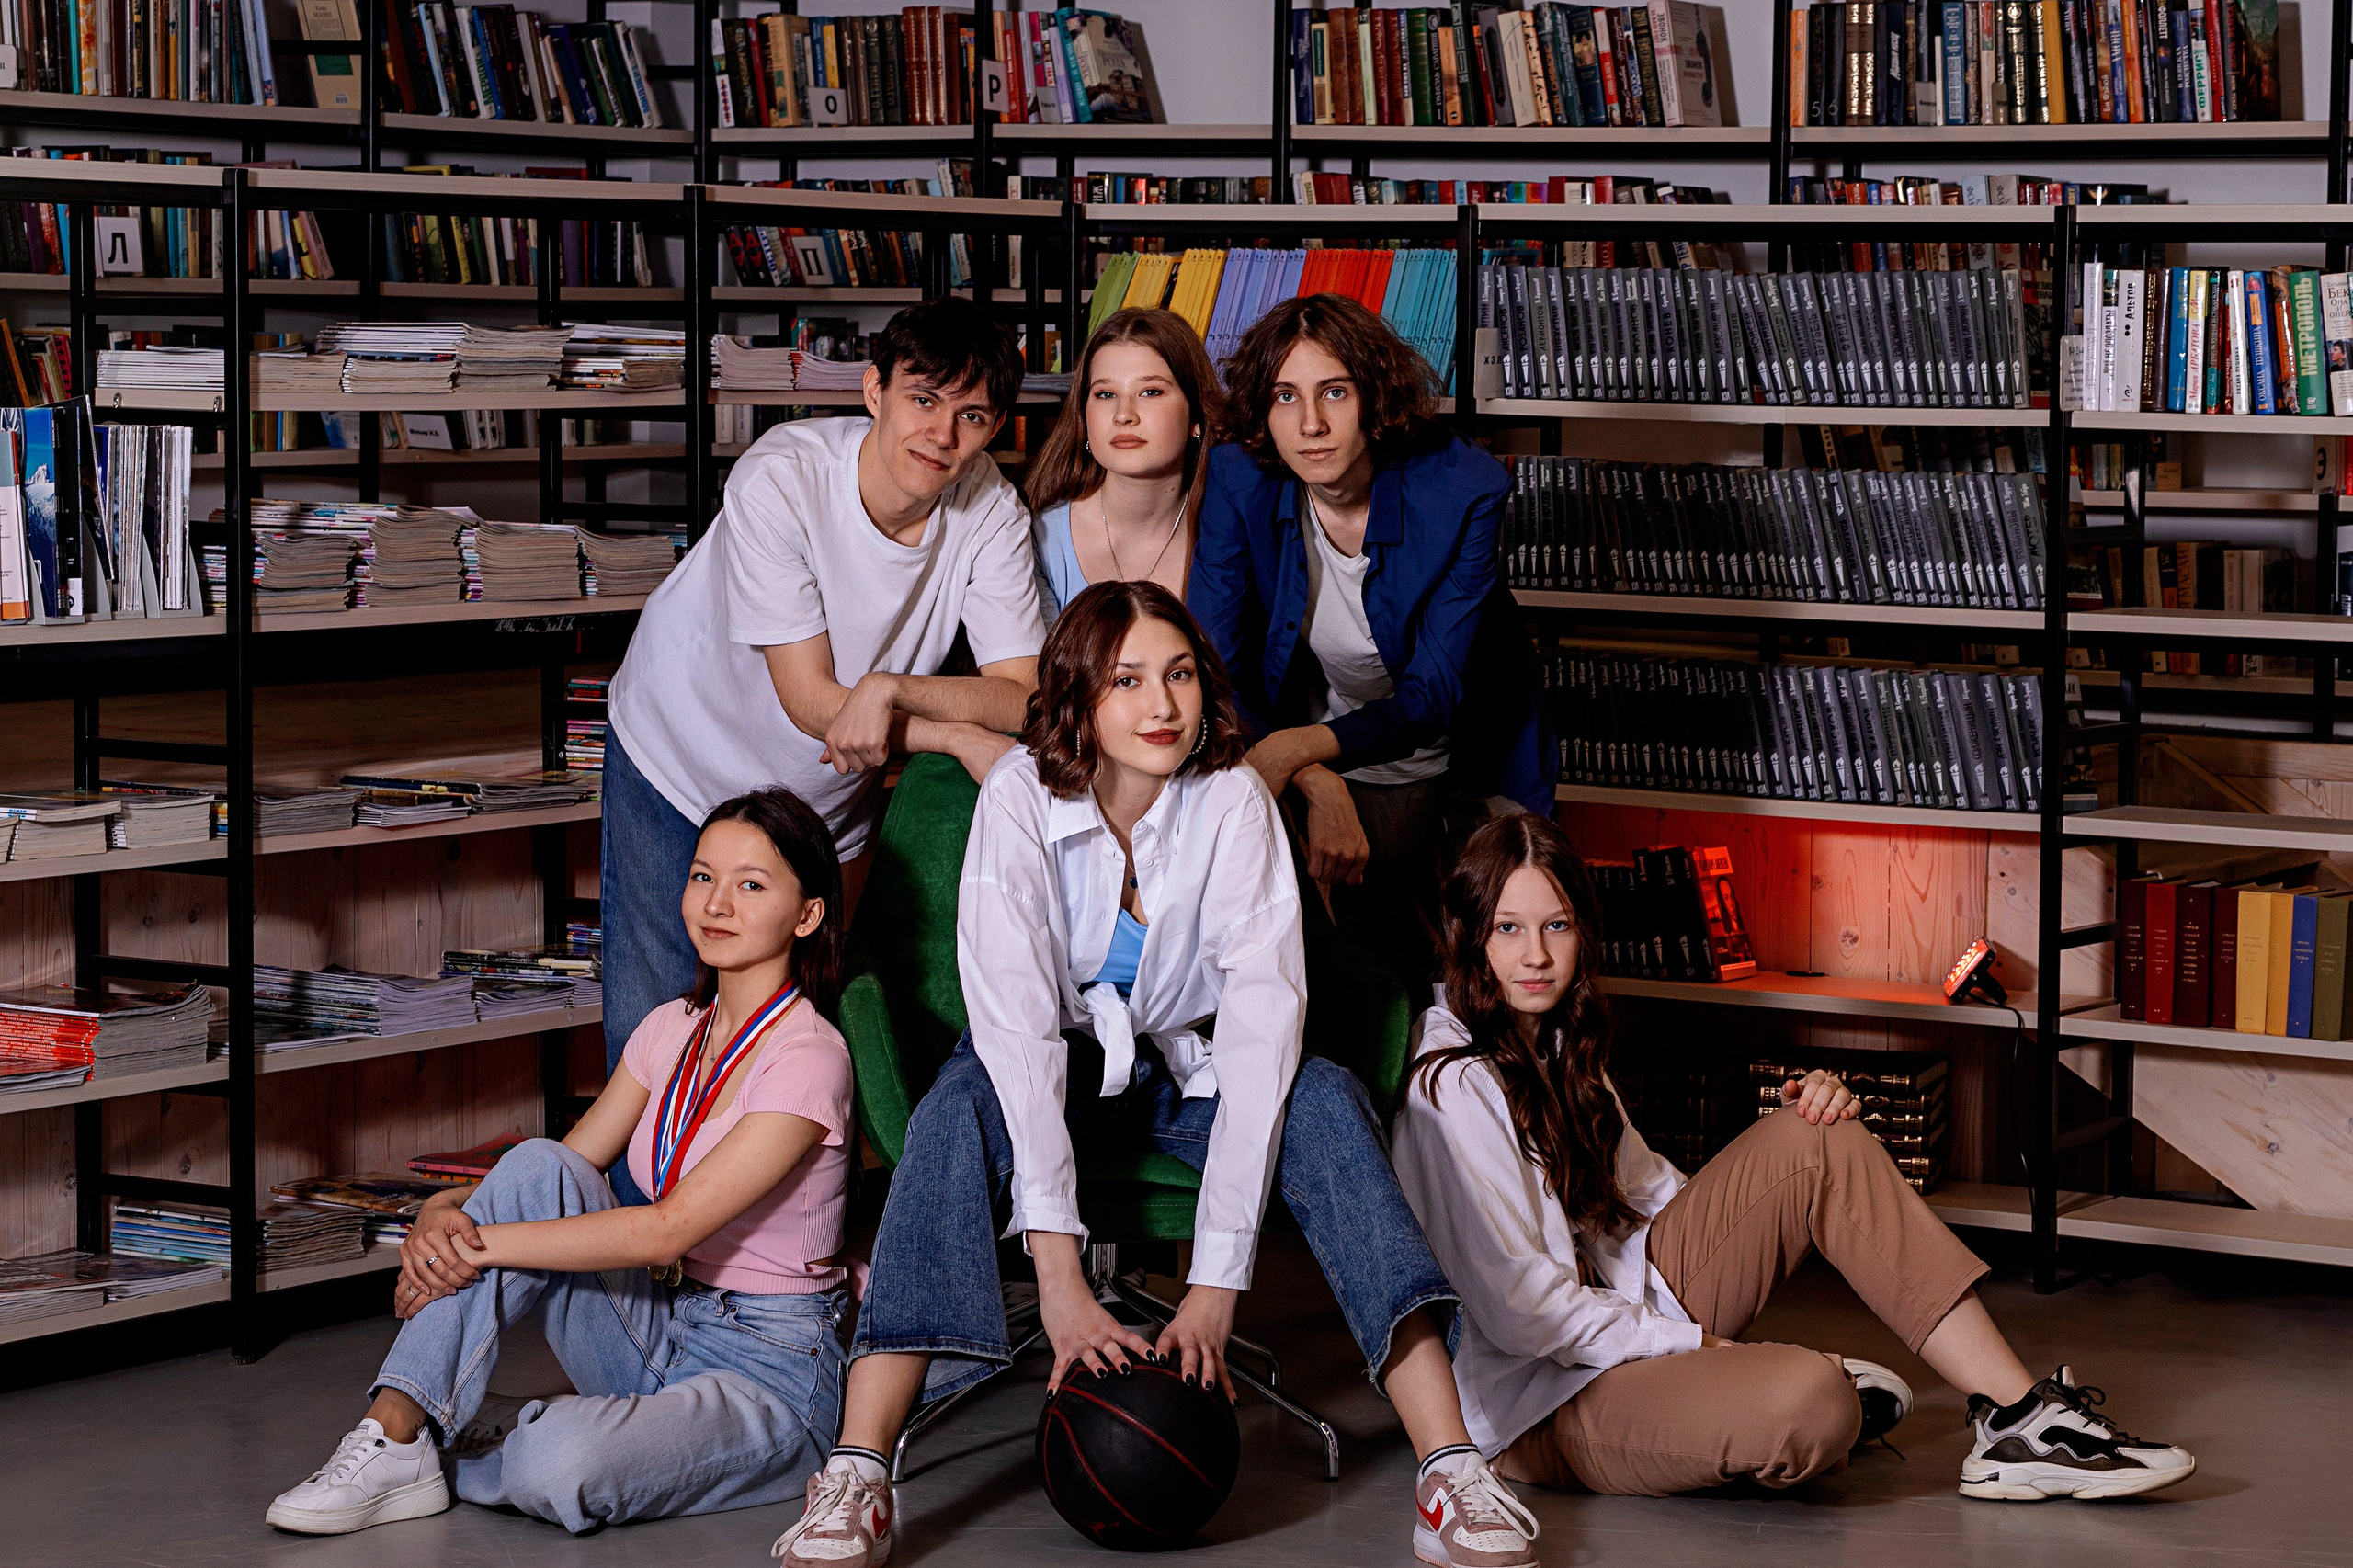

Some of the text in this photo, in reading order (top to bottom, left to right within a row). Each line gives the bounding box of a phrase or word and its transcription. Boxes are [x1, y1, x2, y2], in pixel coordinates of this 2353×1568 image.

[989, 74, 1001, 103] Р
[2195, 54, 2206, 108] ФЕРРИС
[825, 96, 836, 114] О
[1811, 100, 1821, 118] 5
[1828, 98, 1838, 116] 6
[108, 233, 129, 264] Л
[800, 249, 824, 276] П
[1499, 308, 1510, 351] АКСЕНОВ
[1517, 305, 1527, 351] РОЗАНОВ
[1537, 305, 1546, 351] ЛЕРМОНТОВ
[1552, 306, 1563, 352] ШЕКСПИР
[1630, 304, 1640, 353] РОЗАНОВ
[1663, 312, 1675, 353] КОНЕВ
[1809, 313, 1824, 356] ВРУБЕЛЬ
[1836, 313, 1851, 351] ФРЕЙД
[1903, 320, 1916, 359] ТОЛКИН
[1960, 305, 1974, 360] ЮРИЙ ГАГАРИН
[2294, 278, 2318, 376] МЕТРОПОЛЬ
[2253, 326, 2266, 401] ОКСАНА ПУШКИНА
[1839, 519, 1858, 569] КОЛЛОНТАЙ
[1988, 518, 2004, 560] КАРУЗО
[2025, 515, 2040, 556] ЛЮТЕР
[1826, 707, 1840, 753] ЛЕСКОВ
[1963, 703, 1981, 759] СОЛЖЕНИЦЫН
[1988, 708, 2001, 741] СЯОПИН
[2028, 719, 2040, 757] КОЛЧАК
